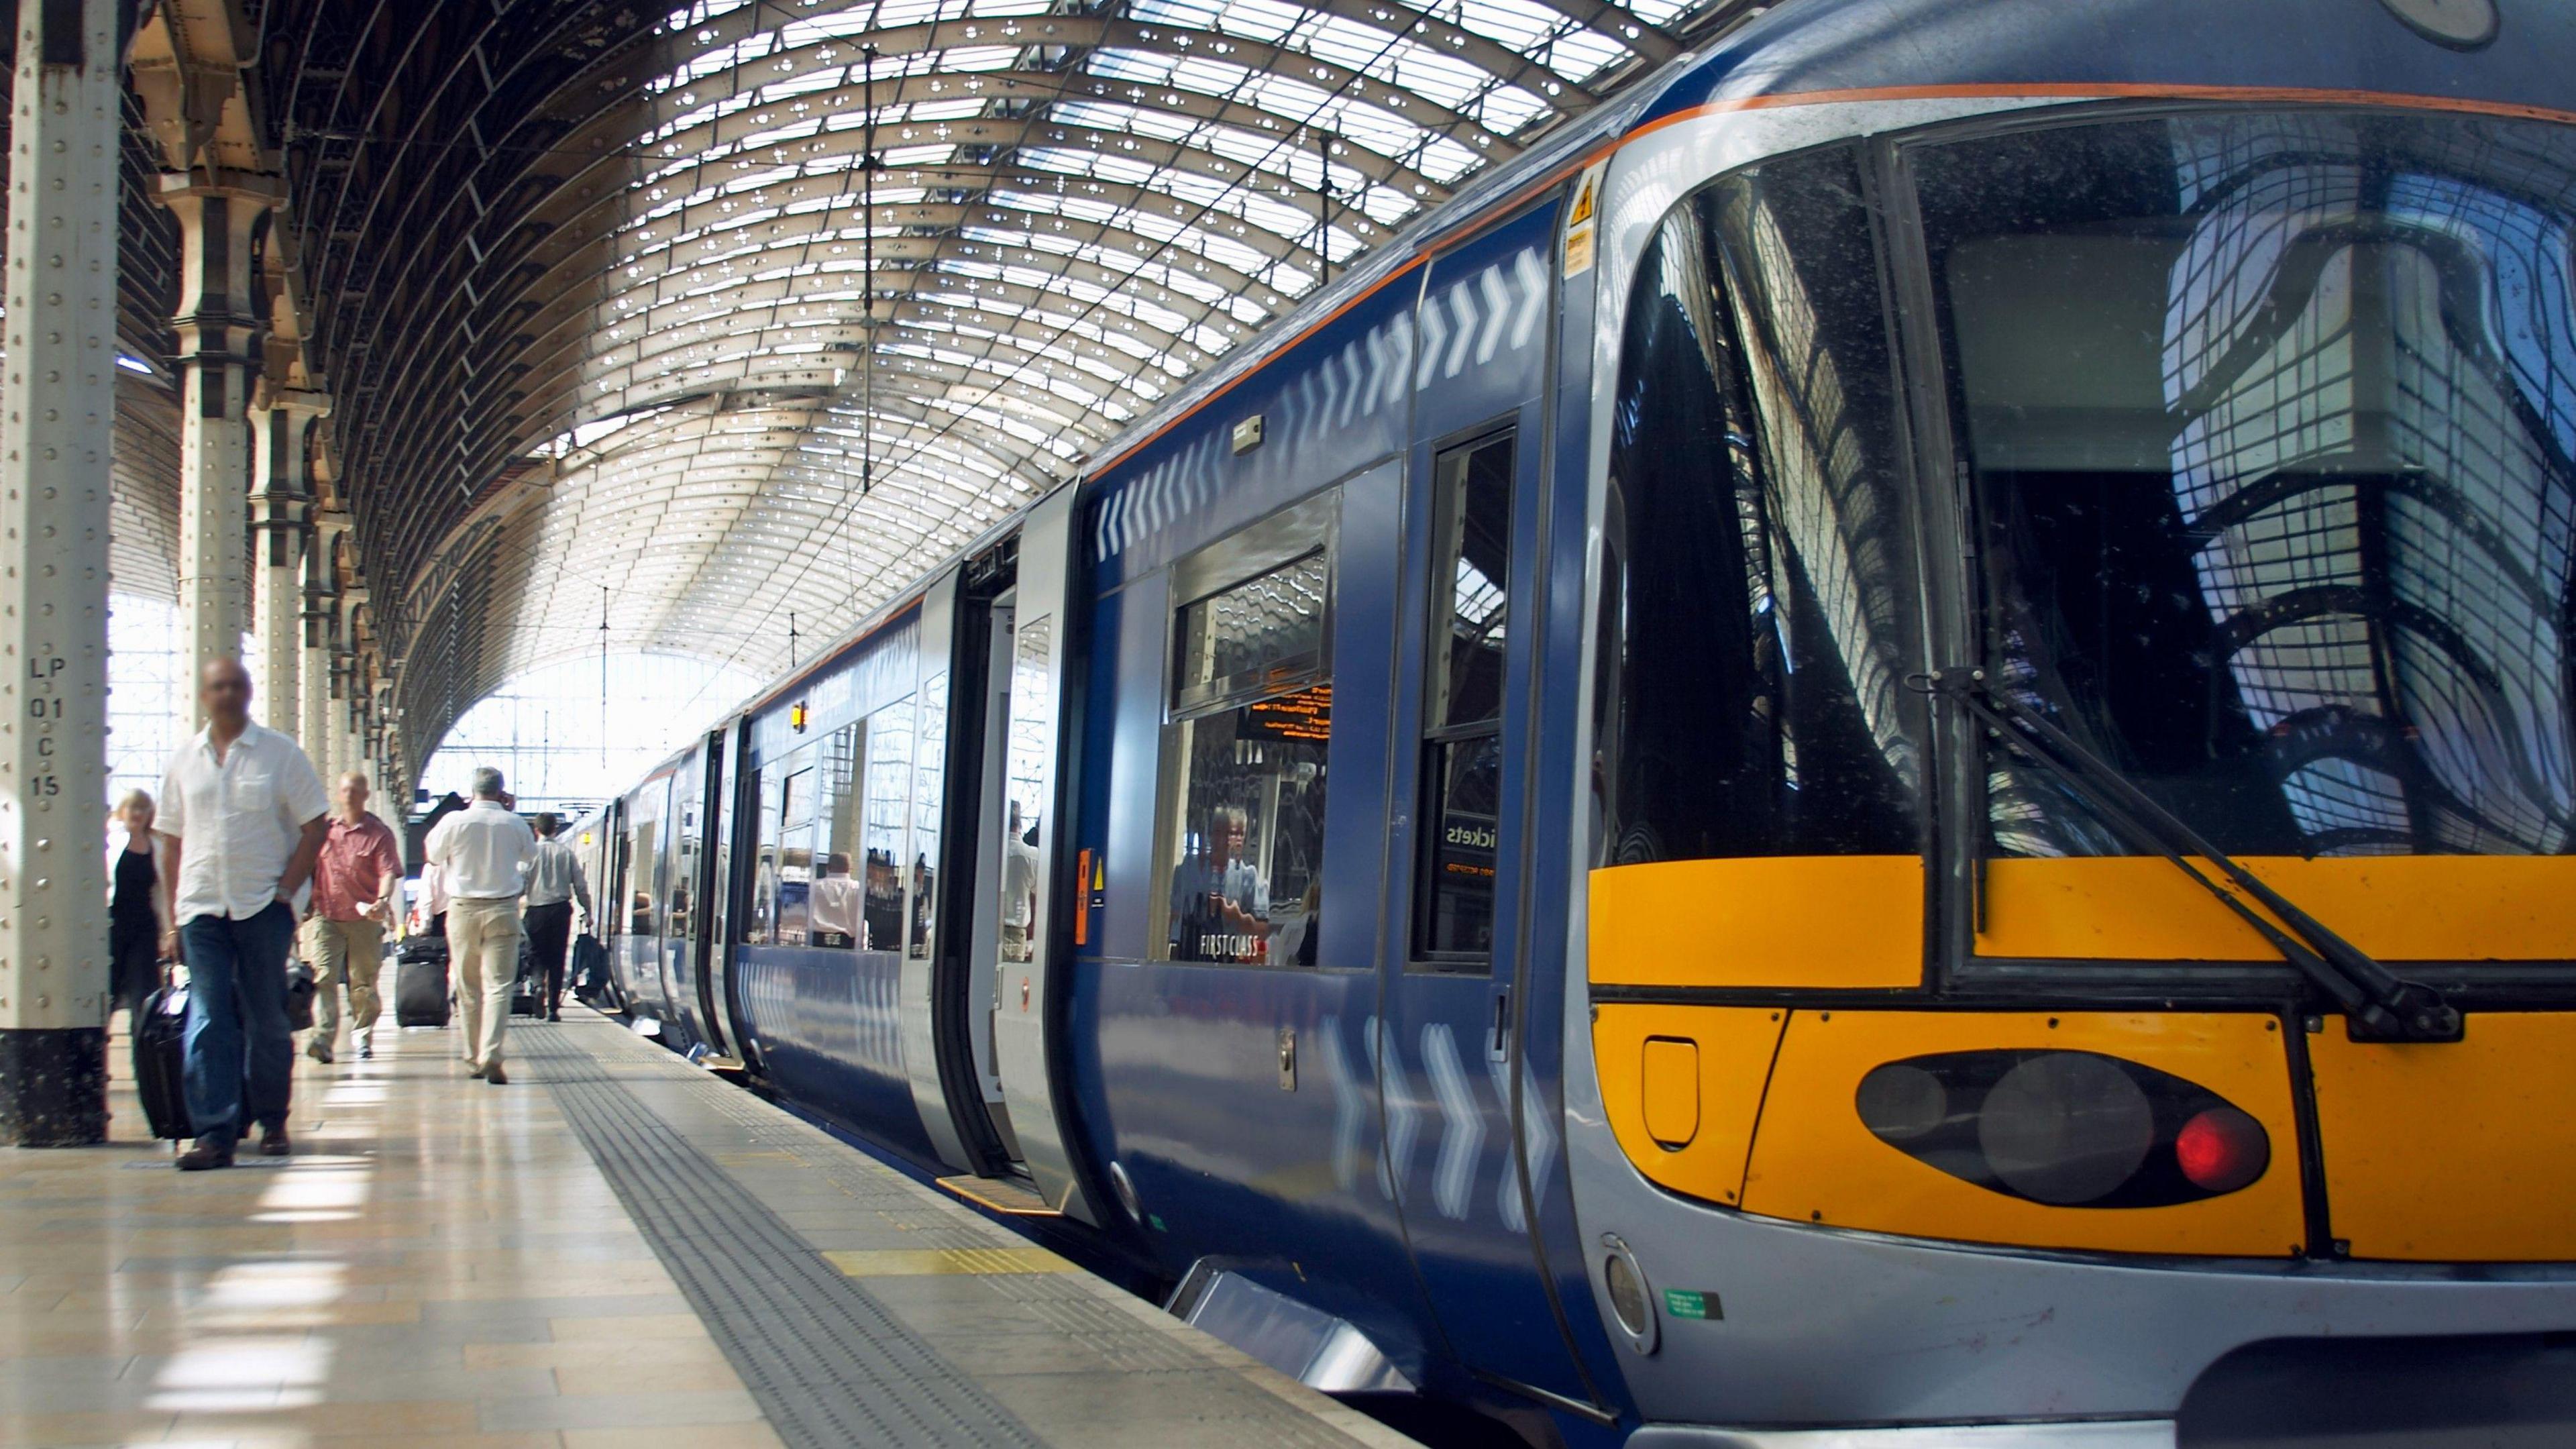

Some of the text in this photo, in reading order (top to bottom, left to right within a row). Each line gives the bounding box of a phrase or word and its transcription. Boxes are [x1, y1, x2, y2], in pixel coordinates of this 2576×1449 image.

[30, 657, 65, 678] LP
[30, 698, 62, 718] 01
[38, 737, 54, 757] C
[32, 775, 60, 796] 15
[1199, 934, 1258, 958] FIRST CLASS
